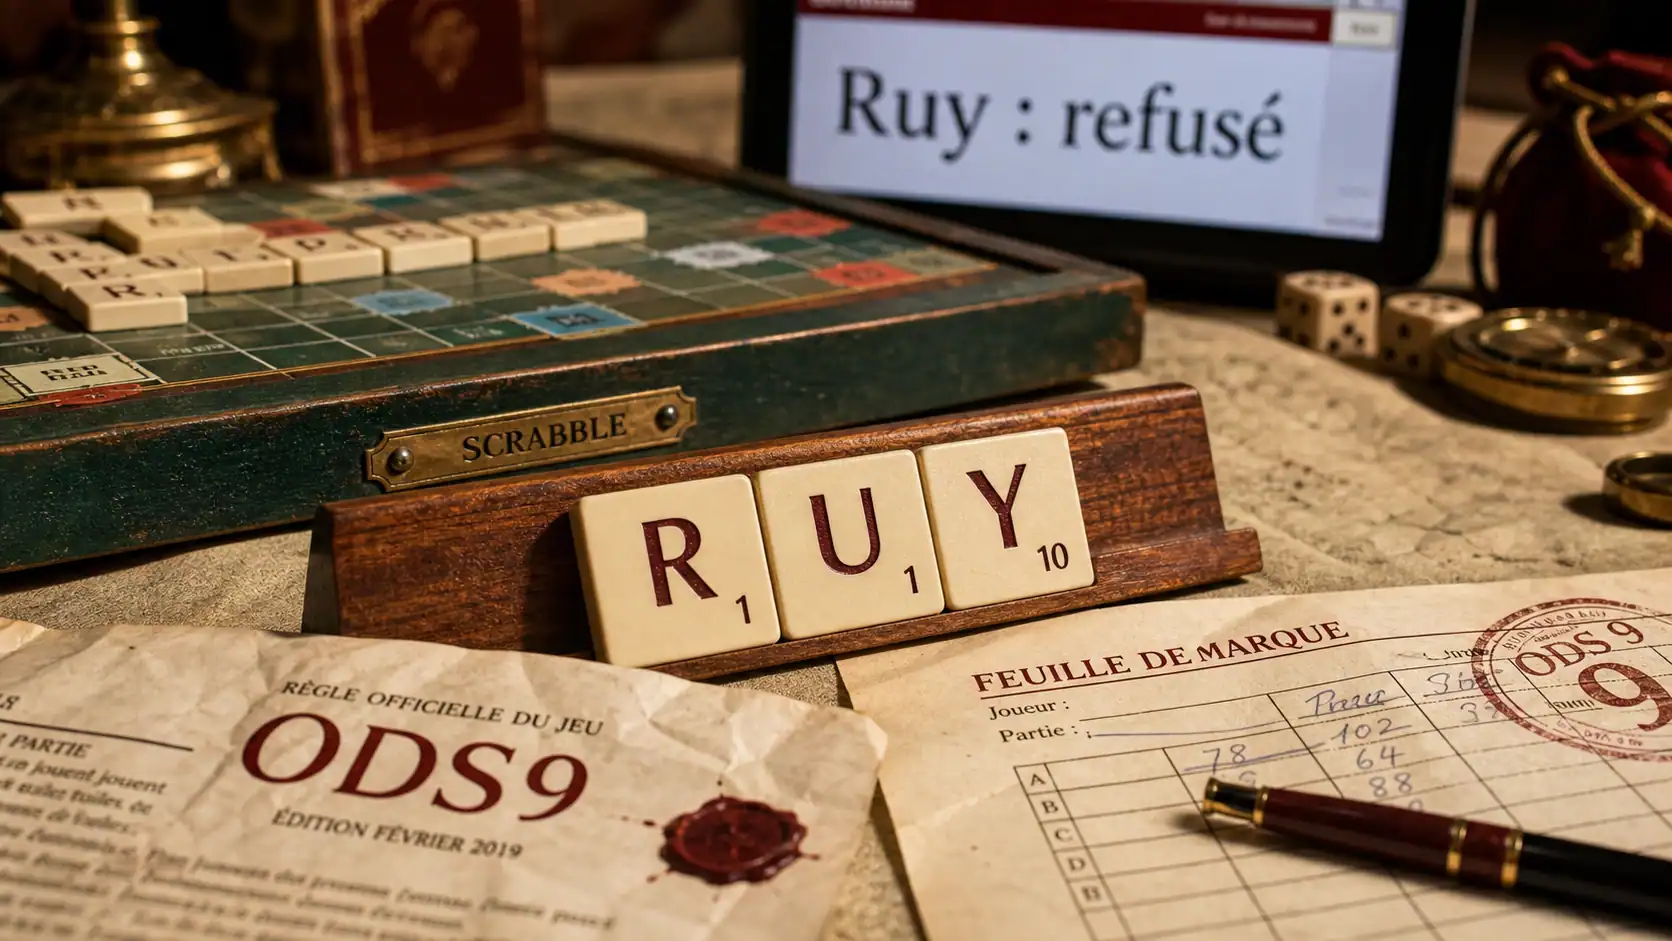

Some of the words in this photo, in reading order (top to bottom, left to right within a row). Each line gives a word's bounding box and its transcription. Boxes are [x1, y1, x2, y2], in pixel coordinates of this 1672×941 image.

[837, 66, 989, 163] Ruy
[1016, 97, 1033, 144] :
[1061, 82, 1286, 163] refusé
[462, 412, 627, 463] SCRABBLE
[641, 516, 719, 608] R
[735, 594, 752, 625] 1
[809, 487, 882, 576] U
[904, 565, 920, 594] 1
[966, 463, 1027, 549] Y
[1037, 542, 1070, 573] 10
[971, 654, 1132, 693] FEUILLE
[1138, 646, 1195, 671] DE
[1196, 620, 1350, 662] MARQUE
[1515, 630, 1612, 677] ODS
[1606, 621, 1644, 645] 9
[280, 680, 361, 703] RÈGLE
[367, 692, 505, 724] OFFICIELLE
[511, 710, 550, 729] DU
[554, 715, 604, 737] JEU
[1578, 662, 1672, 732] 9
[988, 700, 1057, 721] Joueur
[999, 723, 1066, 743] Partie
[1331, 718, 1411, 744] 102
[9, 734, 92, 759] PARTIE
[1356, 745, 1405, 769] 64
[1029, 773, 1046, 788] A
[1368, 771, 1413, 798] 88
[1041, 799, 1058, 813] B
[271, 808, 368, 838] ÉDITION
[372, 823, 464, 854] FÉVRIER
[470, 838, 523, 860] 2019
[1054, 828, 1073, 843] C
[1068, 856, 1086, 872] D
